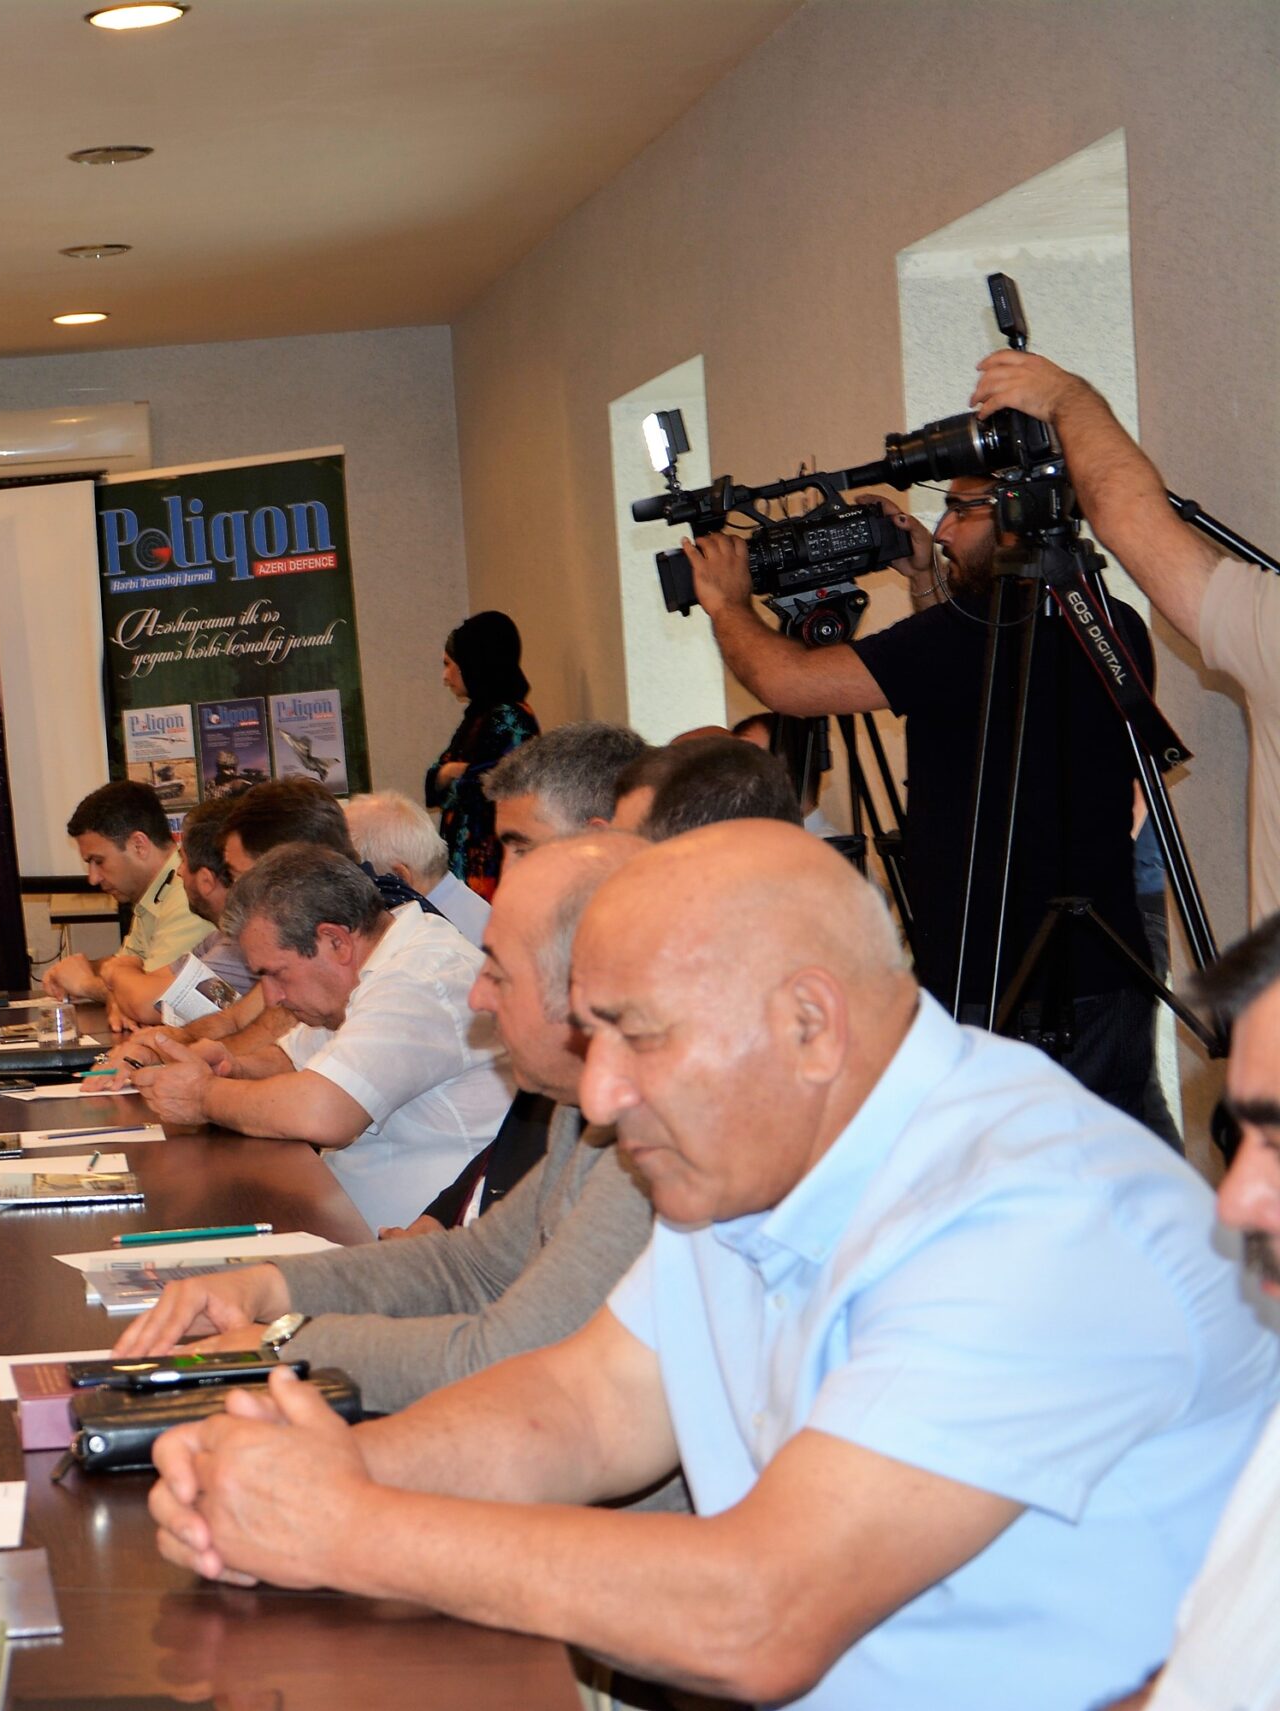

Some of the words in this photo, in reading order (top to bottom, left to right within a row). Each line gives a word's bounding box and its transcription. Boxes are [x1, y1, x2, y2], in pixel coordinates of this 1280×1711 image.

[838, 509, 863, 519] SONY
[99, 496, 336, 581] Poliqon
[258, 561, 287, 575] AZERI
[290, 556, 335, 571] DEFENCE
[141, 574, 182, 588] Texnoloji
[184, 569, 213, 586] Jurnal
[238, 599, 272, 626] ilk
[1068, 591, 1094, 624] EOS
[1087, 626, 1127, 685] DIGITAL
